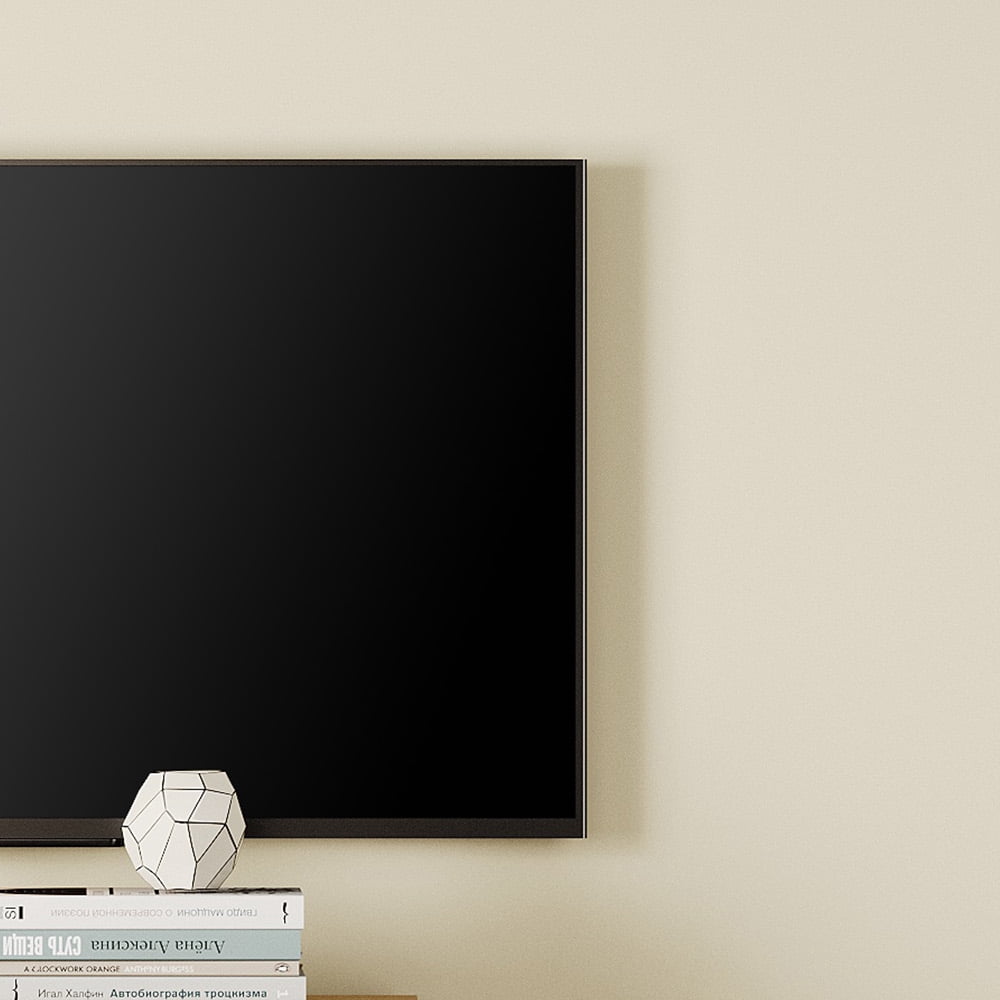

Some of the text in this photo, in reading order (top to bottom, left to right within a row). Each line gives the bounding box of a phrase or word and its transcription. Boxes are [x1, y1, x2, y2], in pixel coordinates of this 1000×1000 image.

[92, 908, 163, 918] СОВРЕМЕННОЙ
[177, 907, 224, 917] МАЦЦОНИ
[226, 907, 257, 917] ГВИДО
[2, 933, 81, 956] СУТЬ ВЕЩИ
[91, 940, 225, 954] Алёна Алексина
[38, 988, 268, 1000] Игал Халфин Автобиография троцкизма
